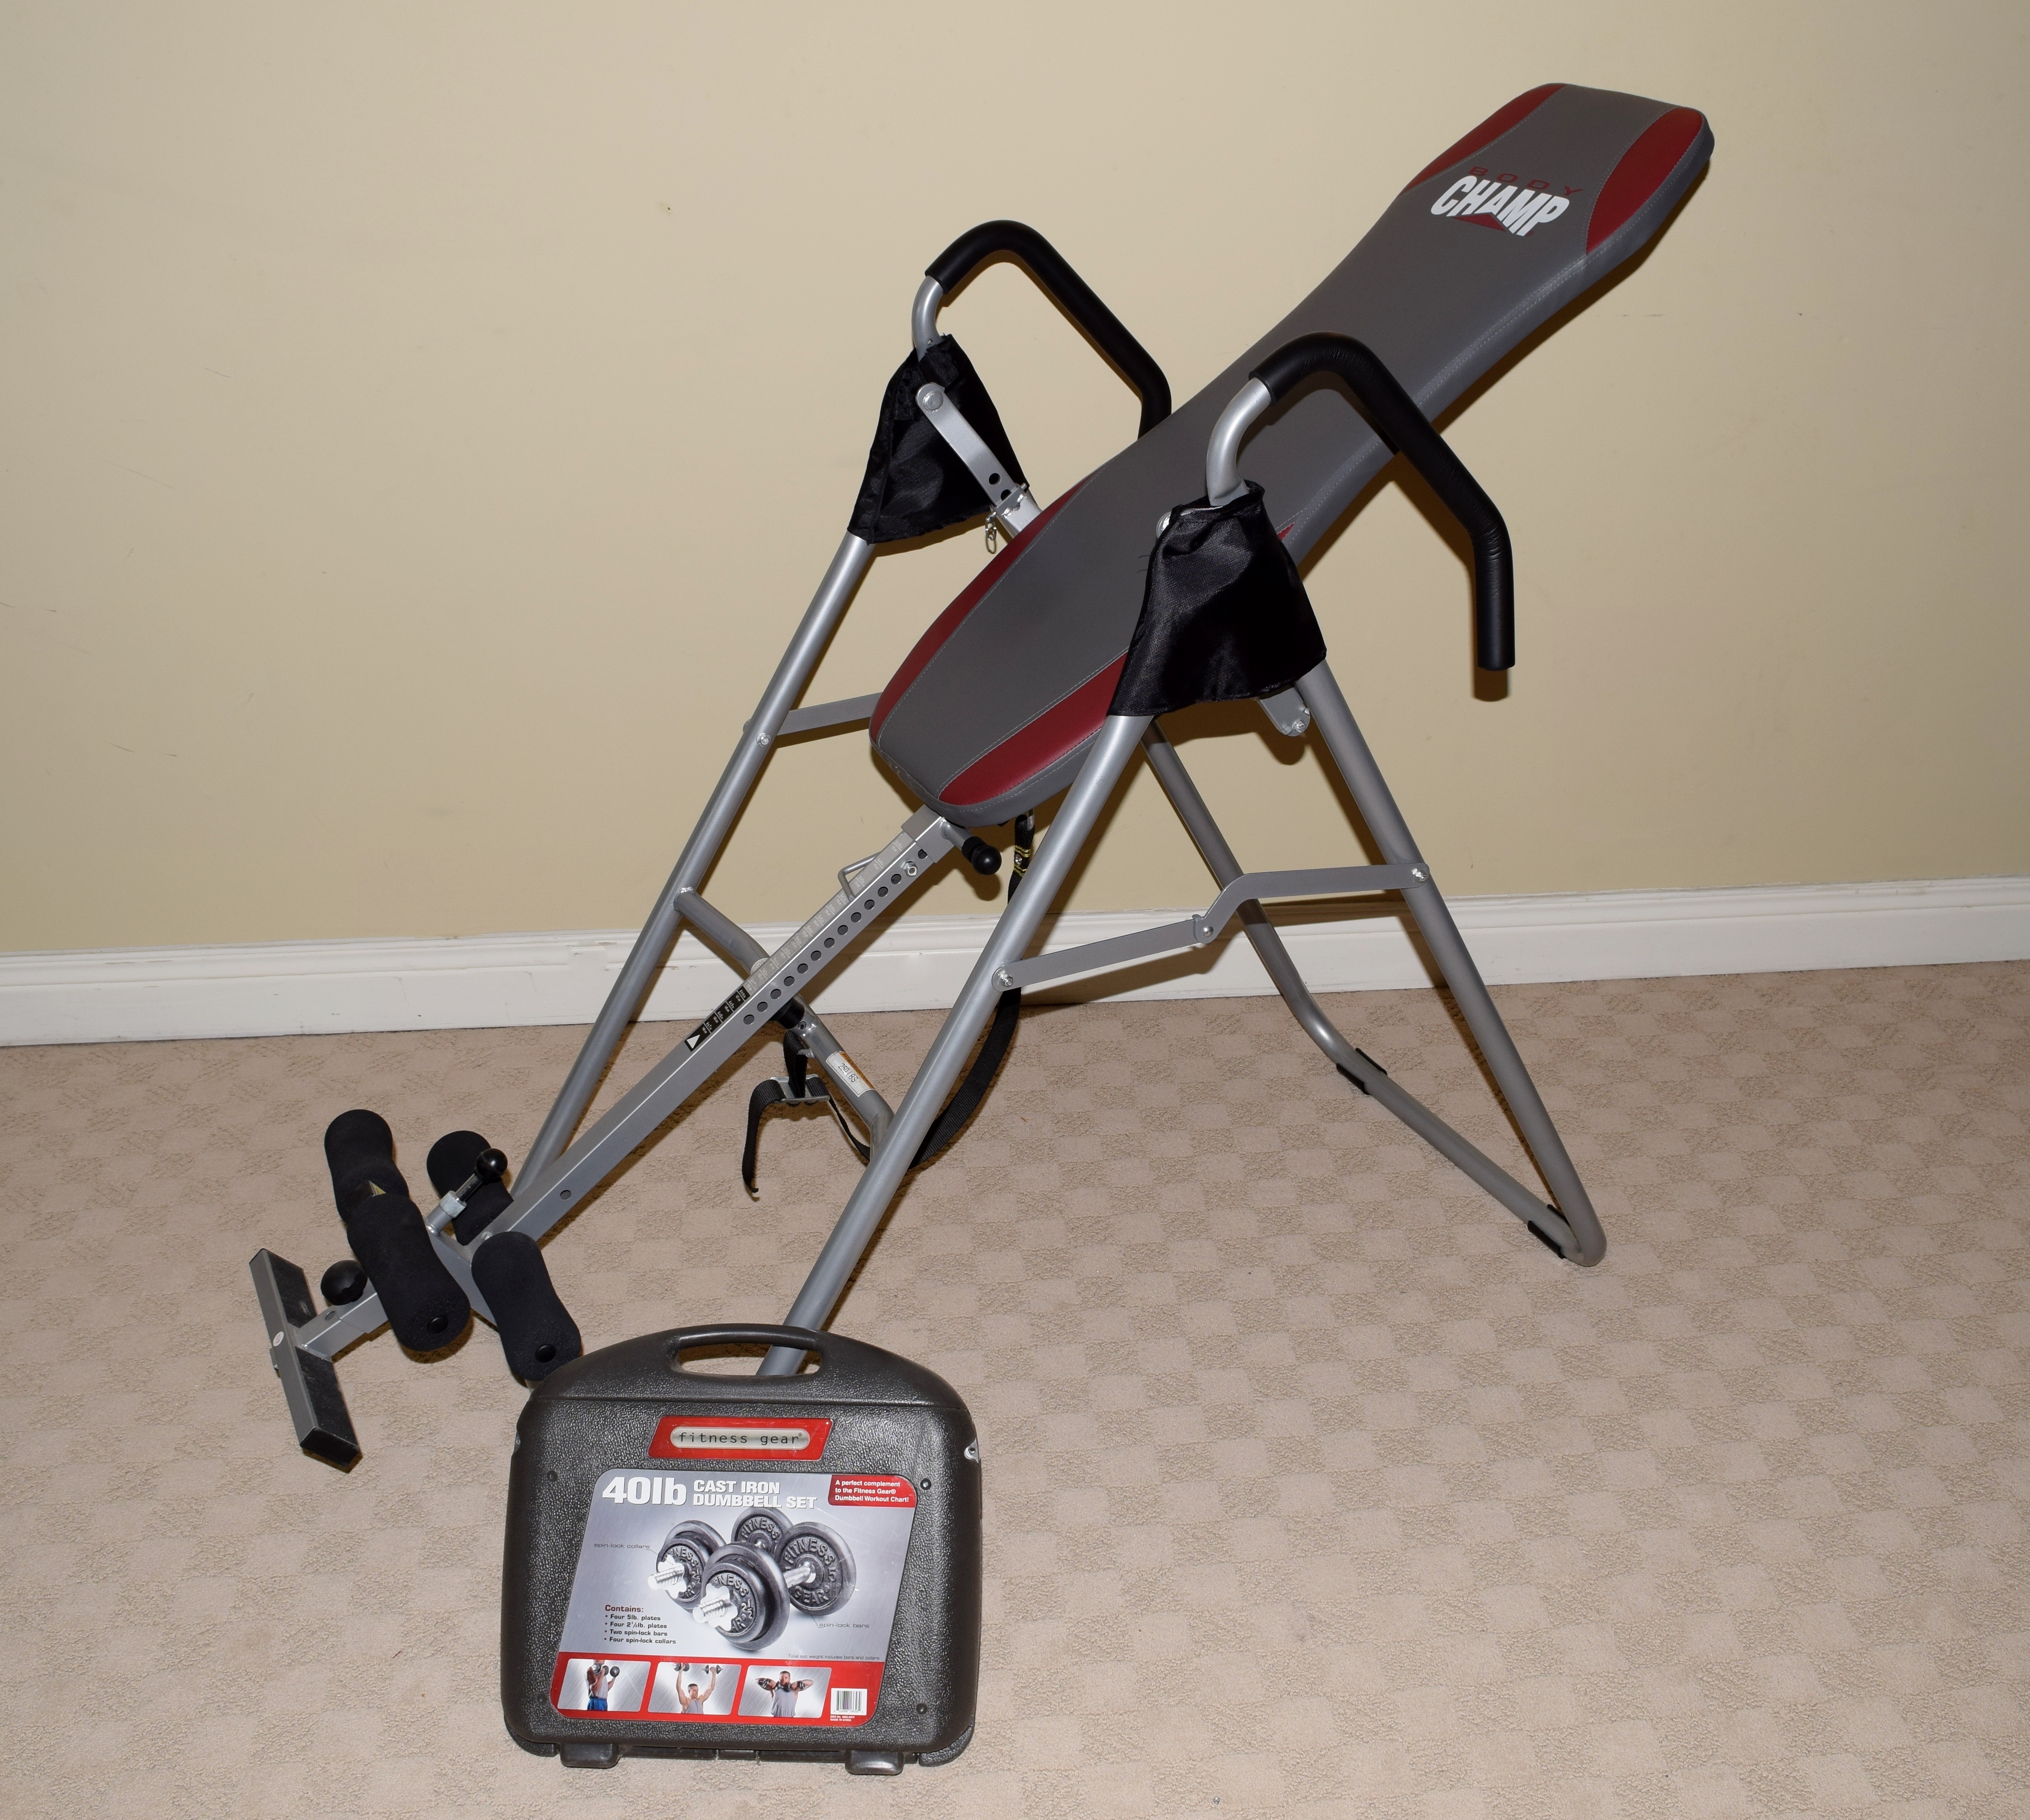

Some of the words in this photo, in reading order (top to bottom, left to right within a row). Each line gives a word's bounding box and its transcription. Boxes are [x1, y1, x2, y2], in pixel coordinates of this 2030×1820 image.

[1468, 166, 1584, 196] BODY
[1431, 175, 1570, 237] CHAMP
[679, 1432, 747, 1443] fitness
[602, 1476, 687, 1506] 40lb
[694, 1480, 737, 1492] CAST
[741, 1481, 780, 1494] IRON
[693, 1493, 782, 1508] DUMBBELL
[786, 1496, 817, 1509] SET
[741, 1517, 781, 1539] FITNESS
[783, 1538, 836, 1565] FITNESS
[828, 1566, 837, 1583] 5
[605, 1604, 644, 1612] Contains:
